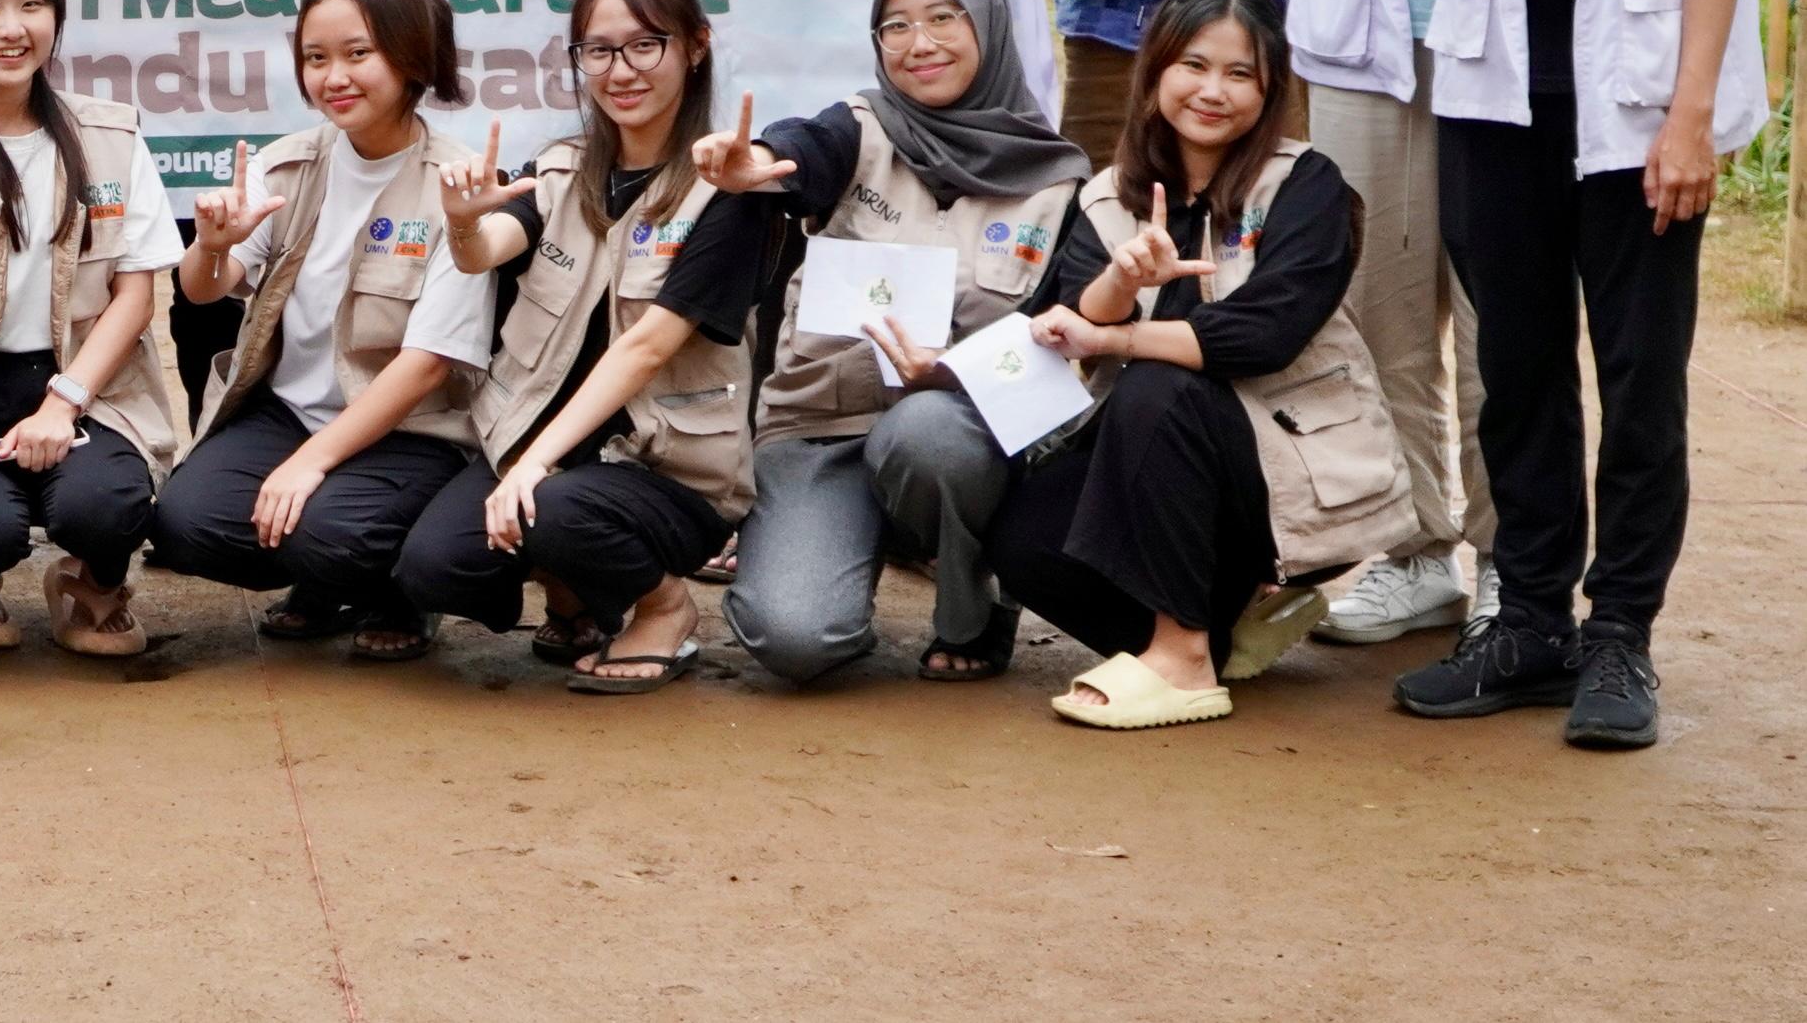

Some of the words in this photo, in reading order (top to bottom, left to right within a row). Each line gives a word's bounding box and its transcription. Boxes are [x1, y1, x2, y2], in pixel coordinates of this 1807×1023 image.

[151, 147, 233, 181] pung
[364, 243, 390, 255] UMN
[538, 237, 577, 272] KEZIA
[627, 247, 650, 259] UMN
[981, 244, 1009, 256] UMN
